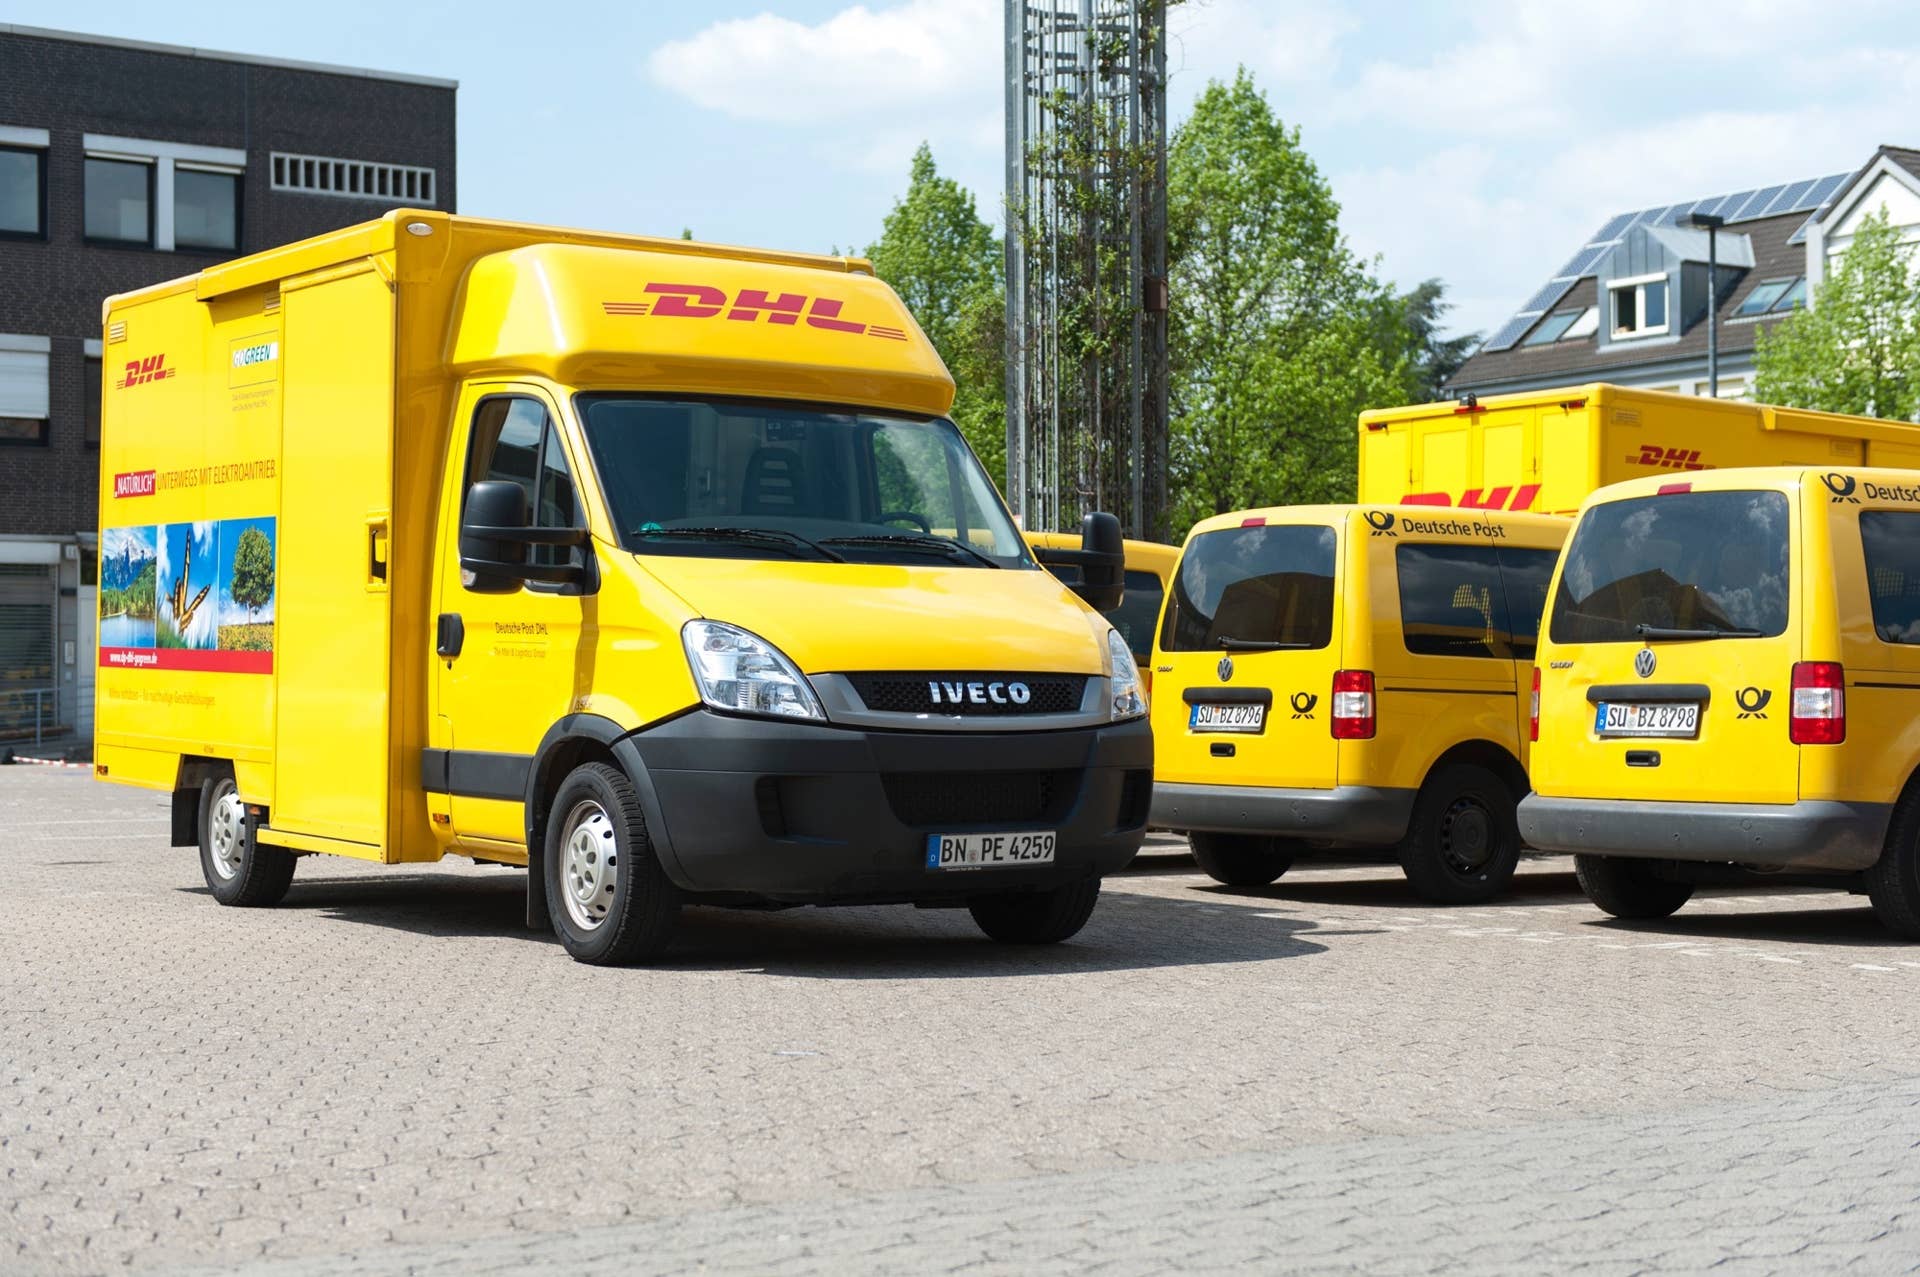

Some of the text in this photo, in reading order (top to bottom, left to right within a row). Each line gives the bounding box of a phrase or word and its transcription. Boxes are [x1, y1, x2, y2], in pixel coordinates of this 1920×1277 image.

[643, 282, 867, 335] DHL
[125, 354, 167, 388] DHL
[1639, 444, 1705, 470] DHL
[157, 469, 198, 491] UNTERWEGS
[200, 467, 213, 486] MIT
[1863, 482, 1920, 502] Deutsc
[1401, 518, 1506, 538] Deutsche Post
[928, 680, 1032, 705] IVECO
[1198, 705, 1261, 724] SU BZ 8796
[1607, 706, 1627, 728] SU
[1637, 706, 1657, 728] BZ
[1659, 706, 1695, 728] 8798
[941, 838, 968, 863] BN
[982, 837, 1005, 862] PE
[1009, 834, 1054, 860] 4259
